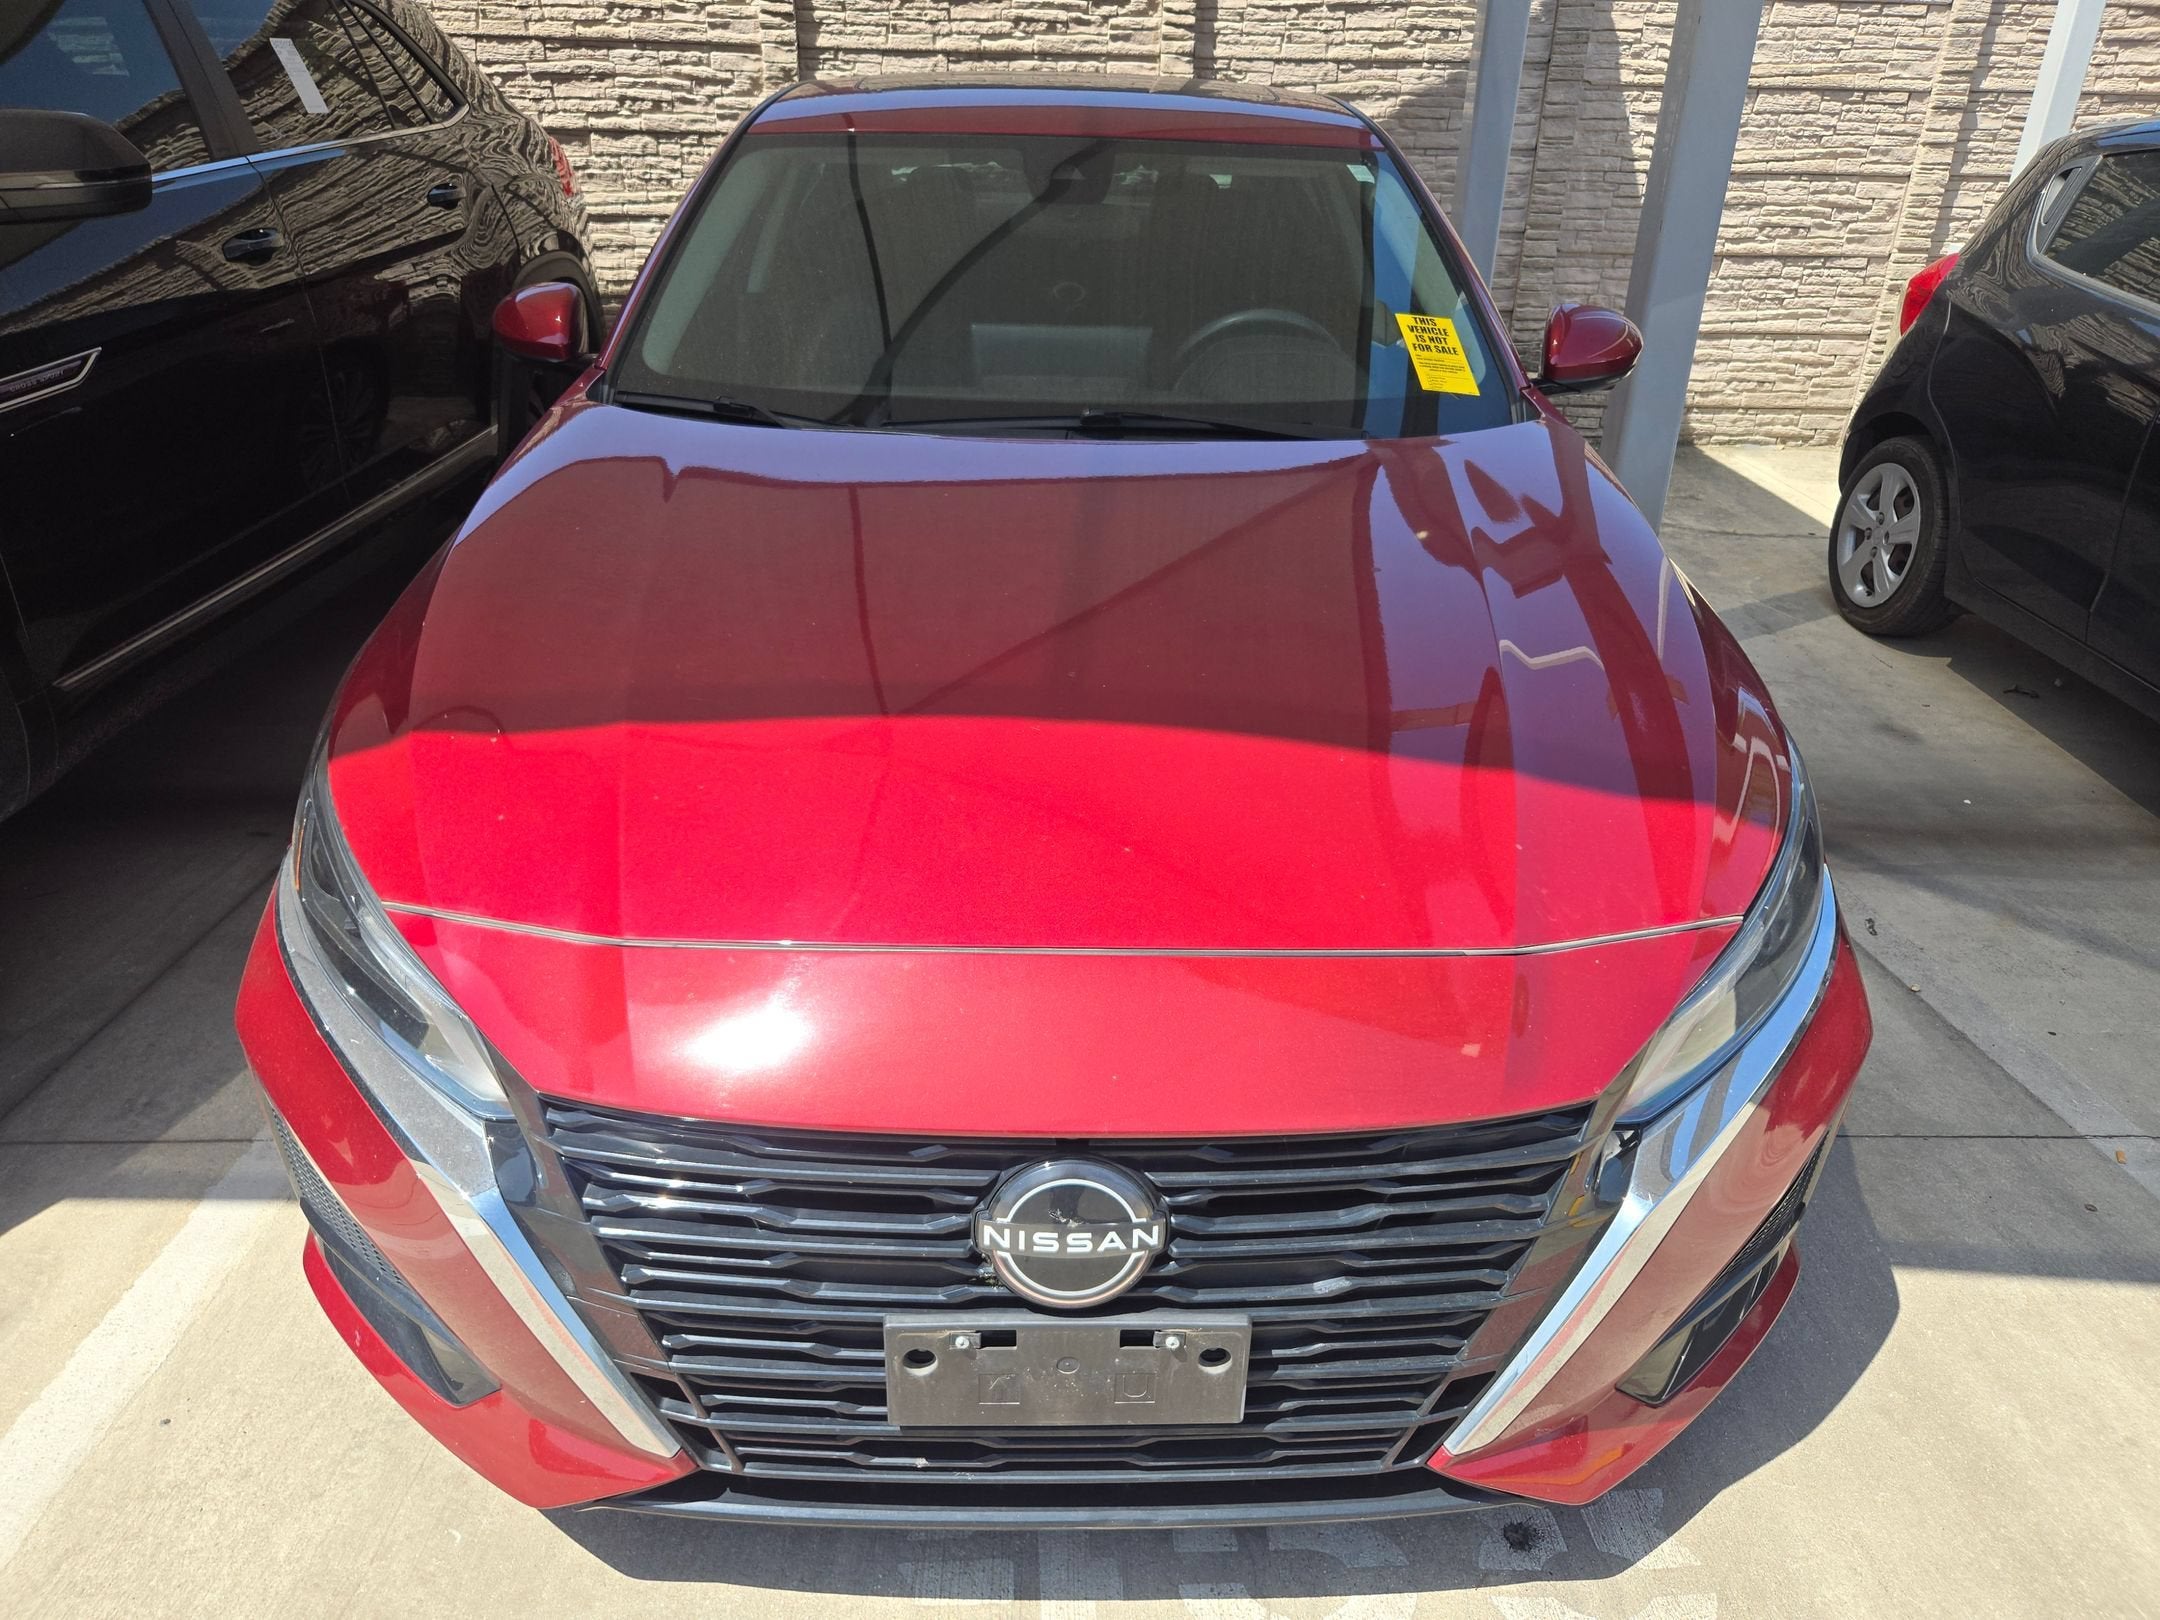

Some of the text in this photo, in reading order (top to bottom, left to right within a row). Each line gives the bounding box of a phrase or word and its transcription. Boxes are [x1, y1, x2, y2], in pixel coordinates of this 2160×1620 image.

[1413, 317, 1437, 326] THIS
[1407, 325, 1449, 336] VEHICLE
[1415, 334, 1448, 345] IS NOT
[1412, 343, 1459, 356] FOR SALE
[983, 1225, 1159, 1253] NISSAN
